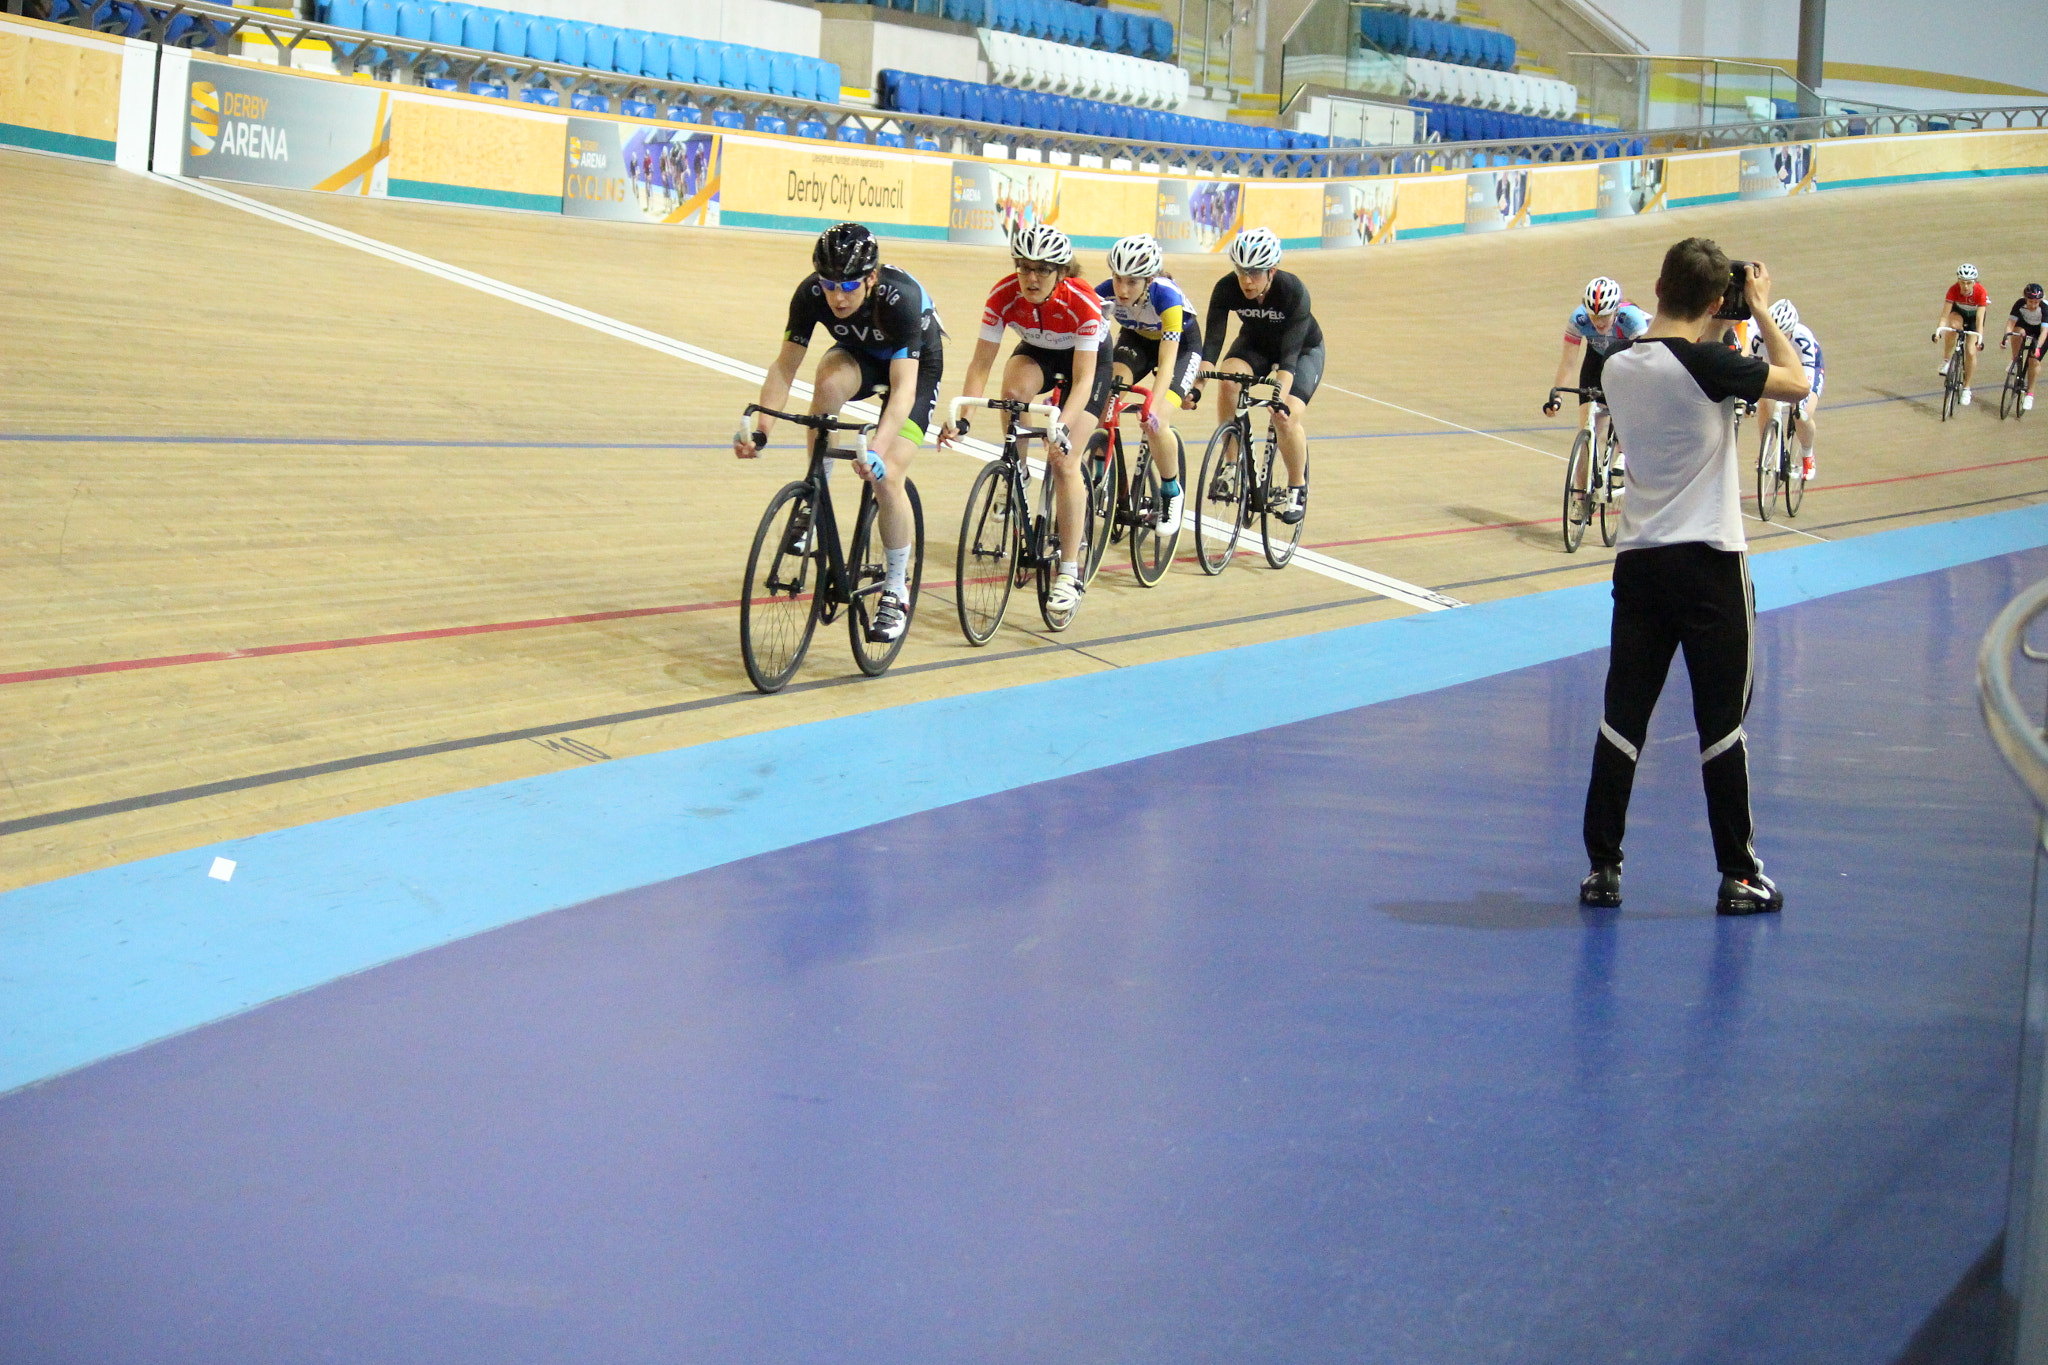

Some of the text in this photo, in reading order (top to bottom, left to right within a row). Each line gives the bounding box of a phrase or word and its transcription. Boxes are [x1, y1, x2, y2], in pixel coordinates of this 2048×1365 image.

[223, 92, 269, 119] DERBY
[220, 121, 289, 161] ARENA
[580, 152, 607, 168] ARENA
[567, 174, 625, 202] CYCLING
[787, 170, 904, 213] Derby City Council
[878, 284, 900, 306] OVB
[834, 324, 885, 342] OVB
[1105, 396, 1116, 423] moda
